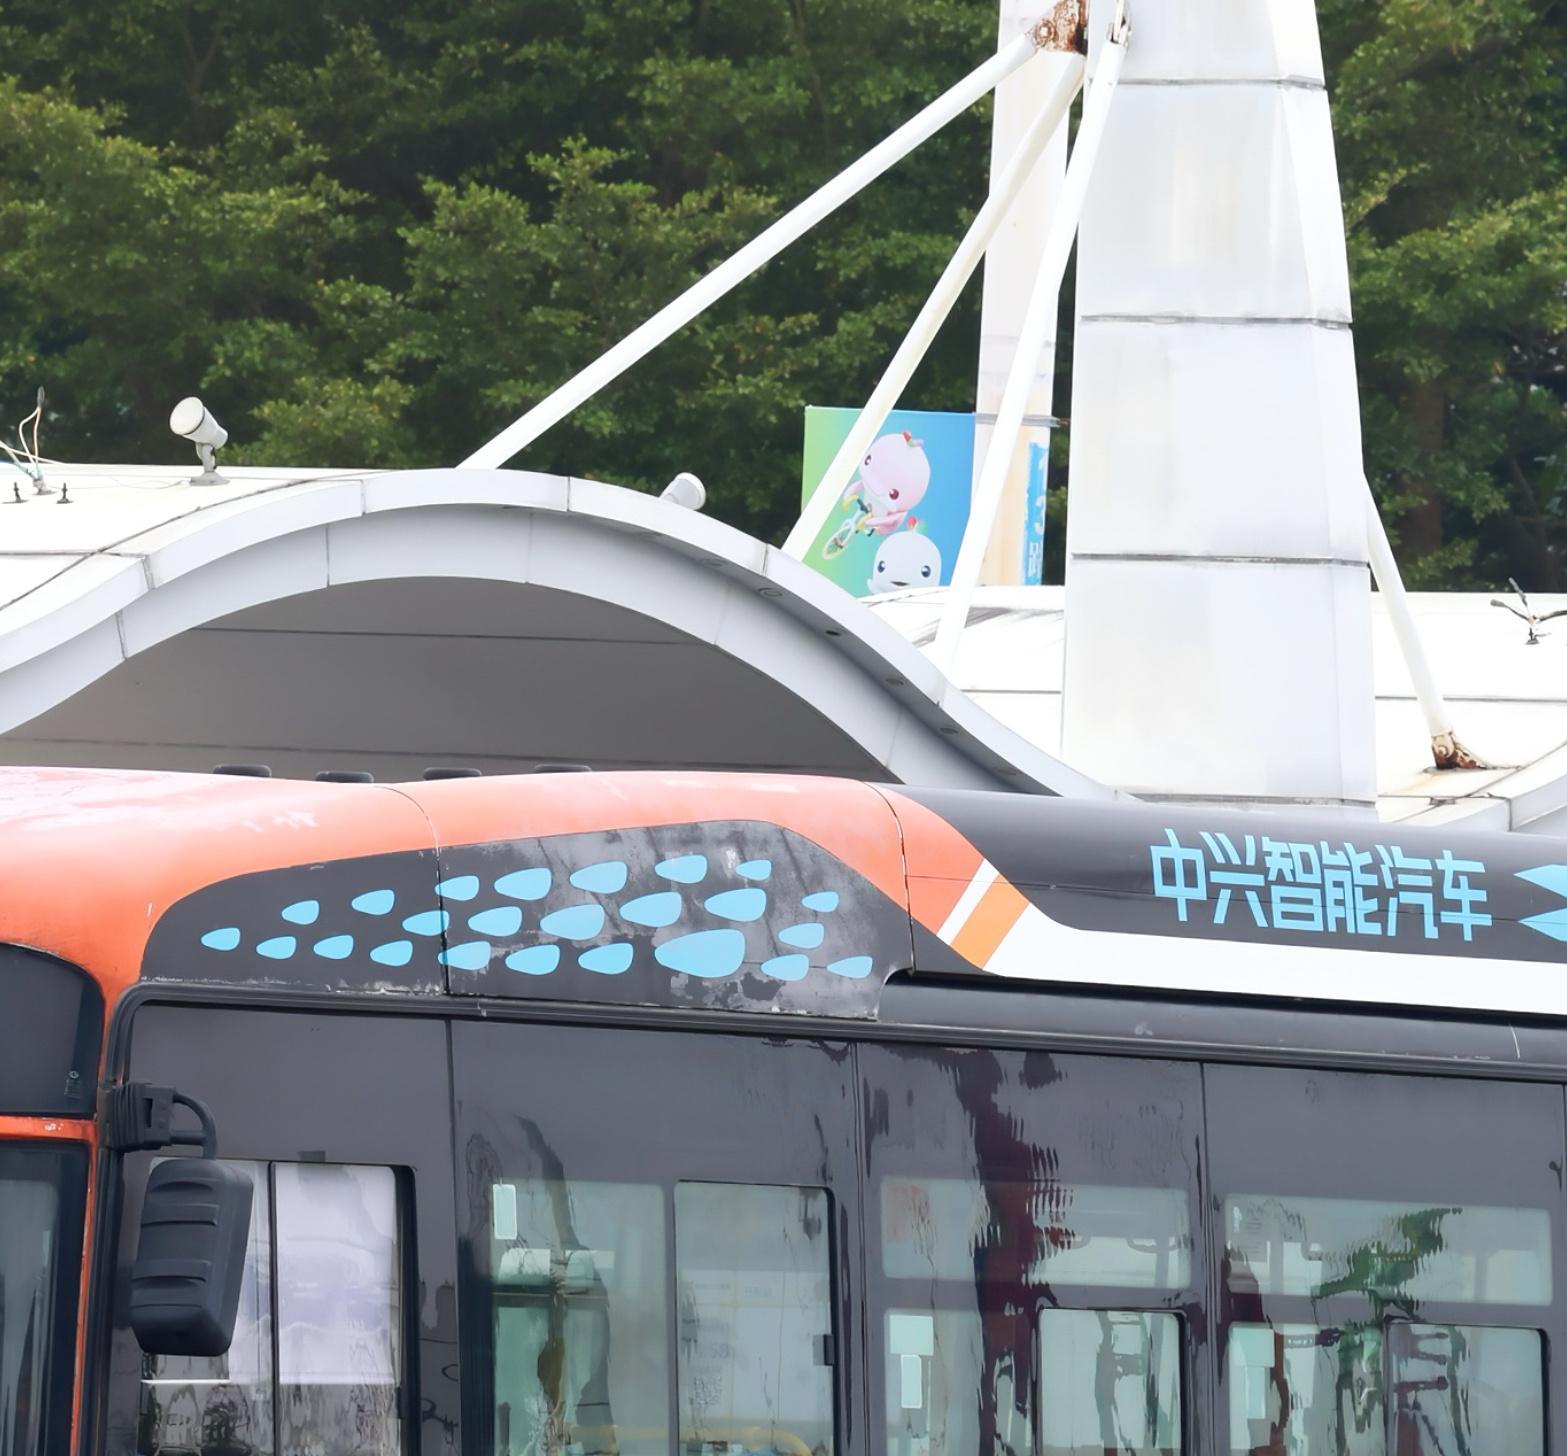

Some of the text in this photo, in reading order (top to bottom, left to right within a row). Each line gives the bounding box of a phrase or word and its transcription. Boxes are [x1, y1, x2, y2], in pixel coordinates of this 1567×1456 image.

[1149, 828, 1493, 942] 中兴智能汽车
